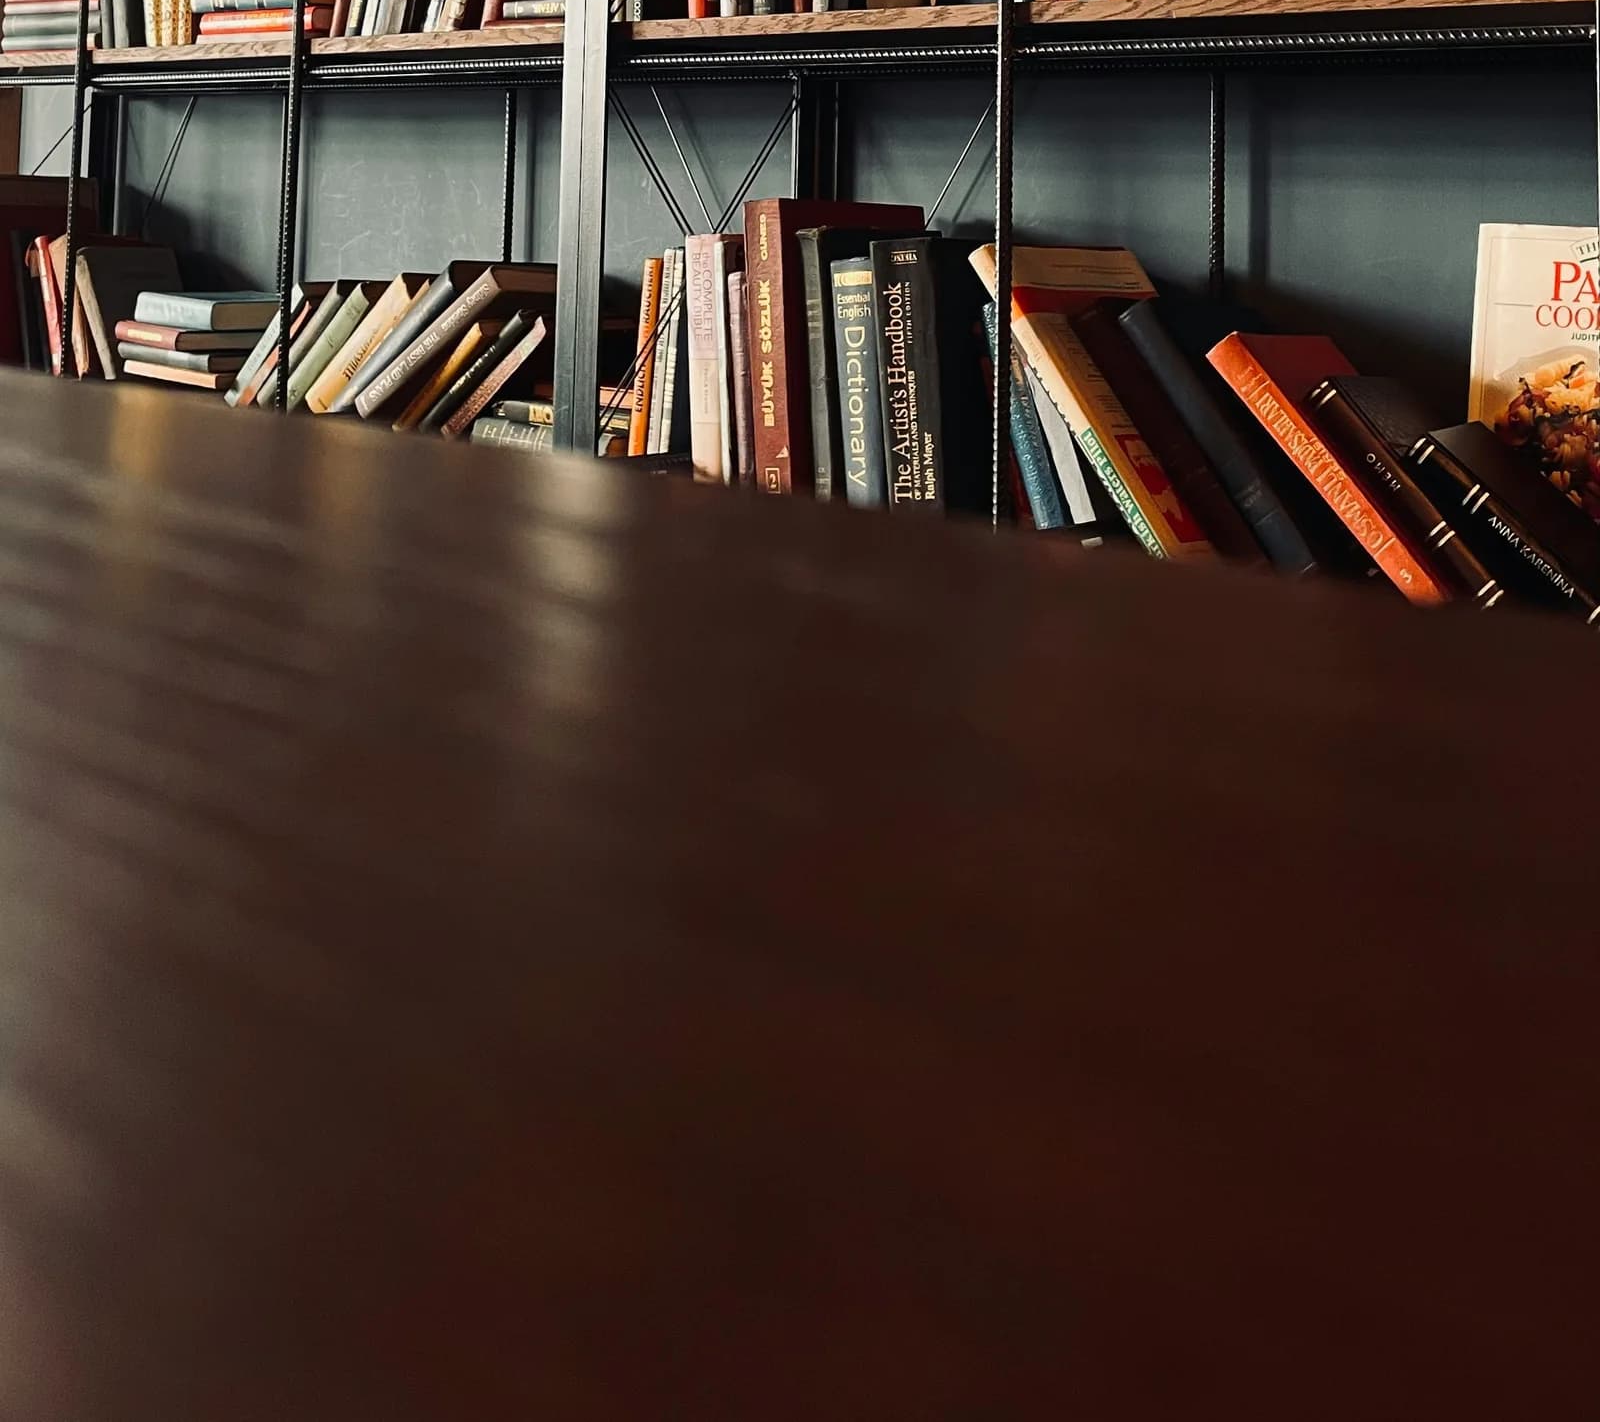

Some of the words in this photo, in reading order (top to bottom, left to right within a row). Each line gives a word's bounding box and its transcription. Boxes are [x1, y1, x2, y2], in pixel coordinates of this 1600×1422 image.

[691, 252, 701, 302] BEAUTY
[837, 291, 871, 305] Essential
[702, 269, 713, 342] COMPLETE
[759, 280, 773, 354] SÖZLÜK
[837, 304, 872, 321] English
[407, 344, 426, 367] BEST
[883, 281, 907, 385] Handbook
[368, 372, 393, 402] PLANS
[391, 359, 410, 383] LAID
[760, 360, 775, 427] BÜYÜK
[844, 326, 869, 487] Dictionary
[907, 370, 918, 421] TECHNIQUES
[890, 388, 912, 458] Artist's
[910, 421, 919, 442] AND
[910, 441, 922, 489] MATERIALS
[923, 431, 935, 466] Mayer
[1081, 429, 1105, 466] Pilot
[894, 463, 914, 504] The
[914, 489, 922, 501] OF
[924, 467, 936, 501] Ralph
[1101, 461, 1136, 513] Waters
[1366, 452, 1401, 492] MEMO
[1321, 468, 1384, 550] OSMANLI
[1132, 510, 1164, 560] urkish
[1488, 516, 1520, 548] ANNA
[1519, 544, 1576, 598] KARENINA
